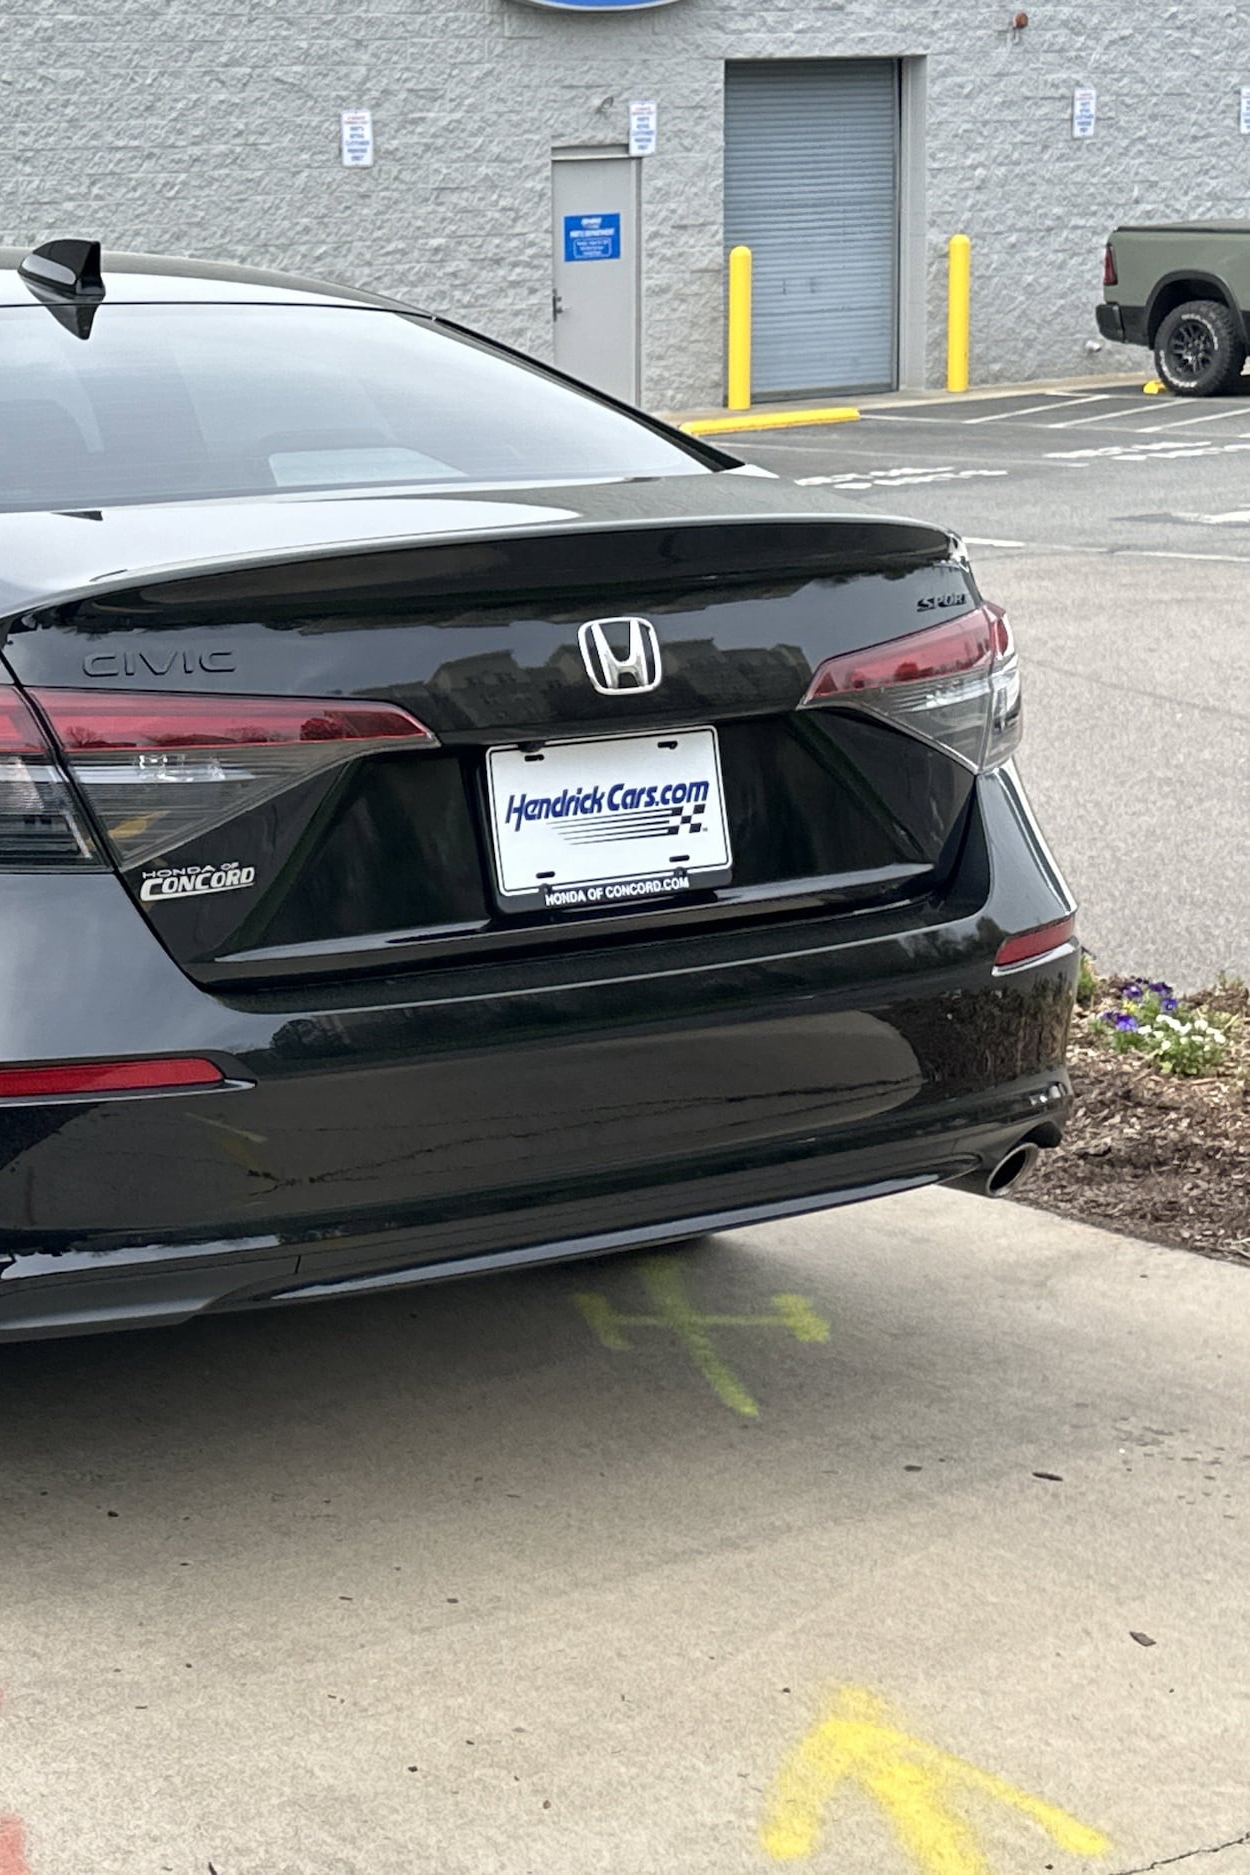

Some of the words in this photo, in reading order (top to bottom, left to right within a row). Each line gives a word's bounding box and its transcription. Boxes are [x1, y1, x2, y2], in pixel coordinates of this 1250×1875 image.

[82, 651, 236, 678] CIVIC
[140, 866, 255, 901] CONCORD
[142, 865, 216, 879] HONDA
[545, 889, 586, 906] HONDA
[587, 887, 603, 900] OF
[606, 876, 690, 898] CONCORD.COM
